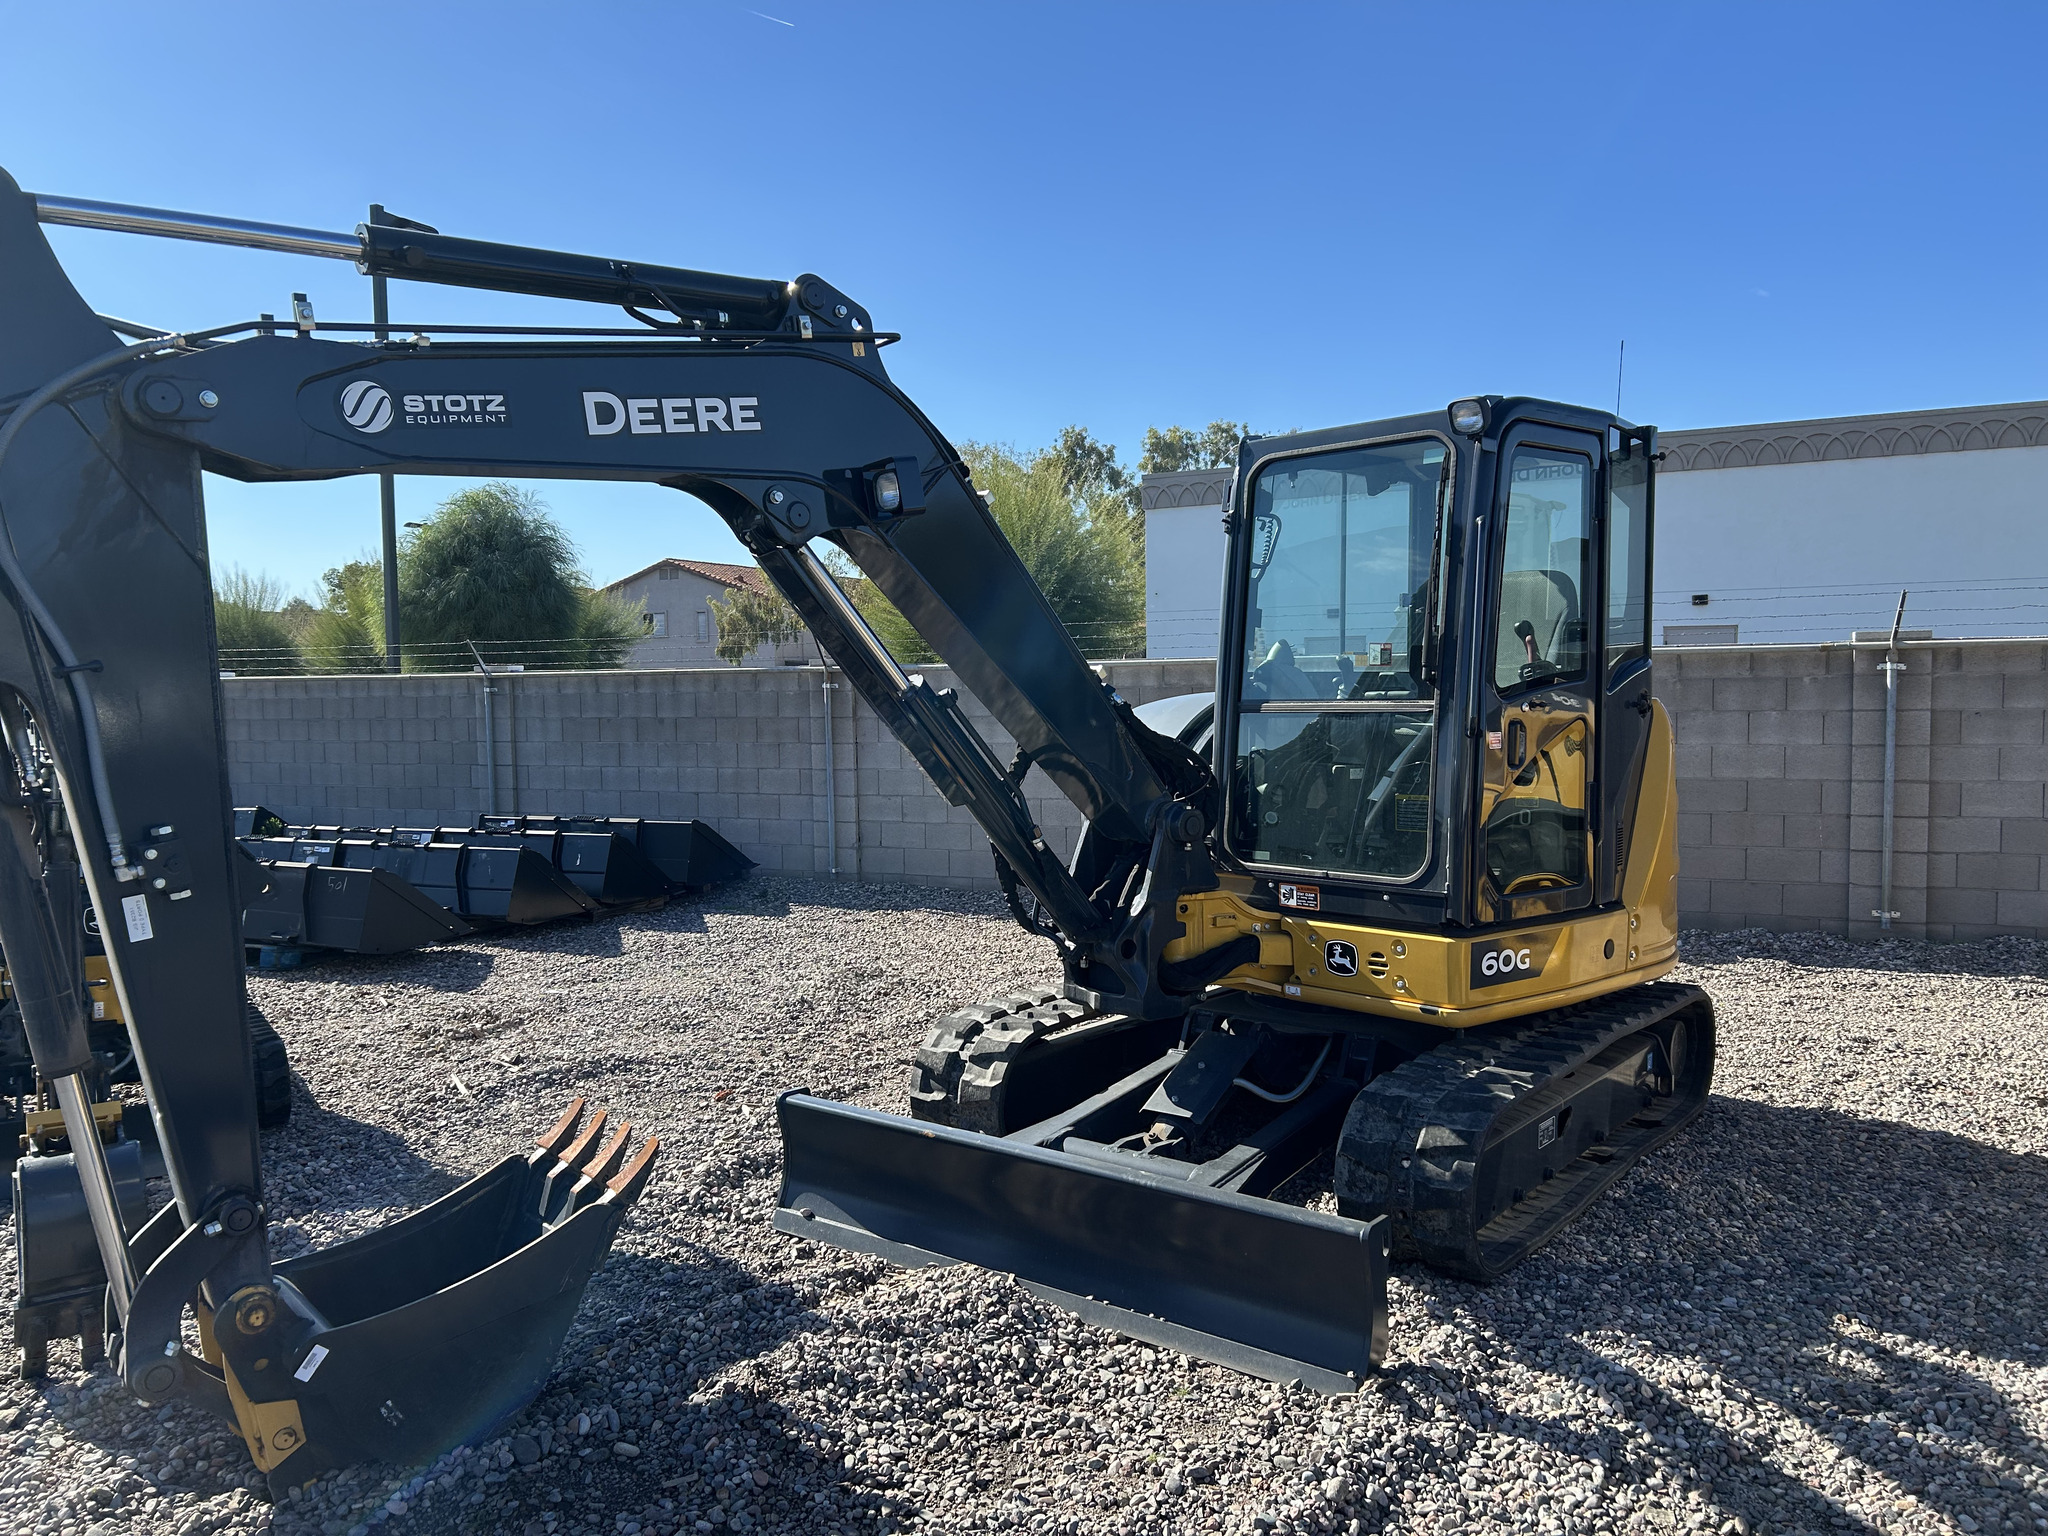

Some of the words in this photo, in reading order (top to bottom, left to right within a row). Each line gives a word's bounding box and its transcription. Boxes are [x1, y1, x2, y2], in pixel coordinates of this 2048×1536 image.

[403, 394, 506, 413] STOTZ
[582, 391, 762, 436] DEERE
[405, 414, 507, 425] EQUIPMENT
[1481, 949, 1531, 976] 60G
